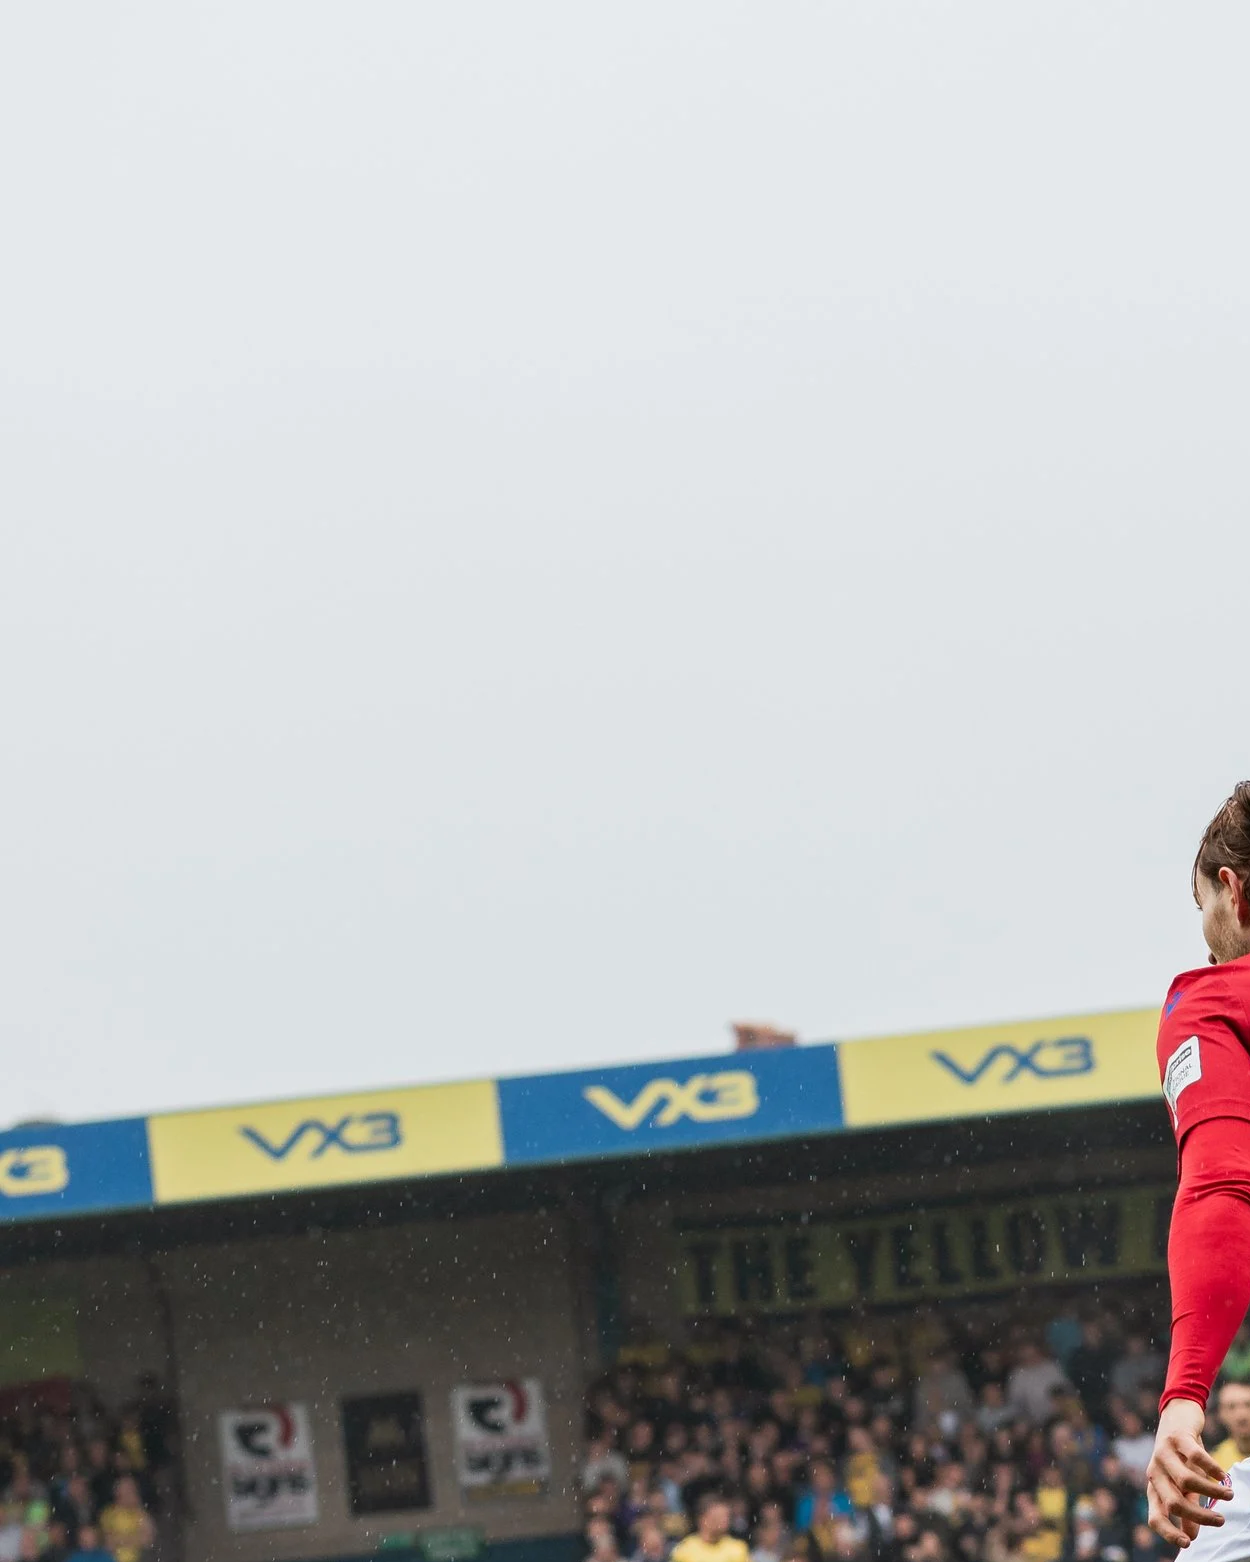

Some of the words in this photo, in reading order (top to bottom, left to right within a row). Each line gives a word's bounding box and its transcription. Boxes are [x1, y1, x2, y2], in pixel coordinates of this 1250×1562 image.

[930, 1036, 1096, 1085] VX3
[585, 1071, 759, 1130] VX3
[238, 1112, 404, 1161] VX3
